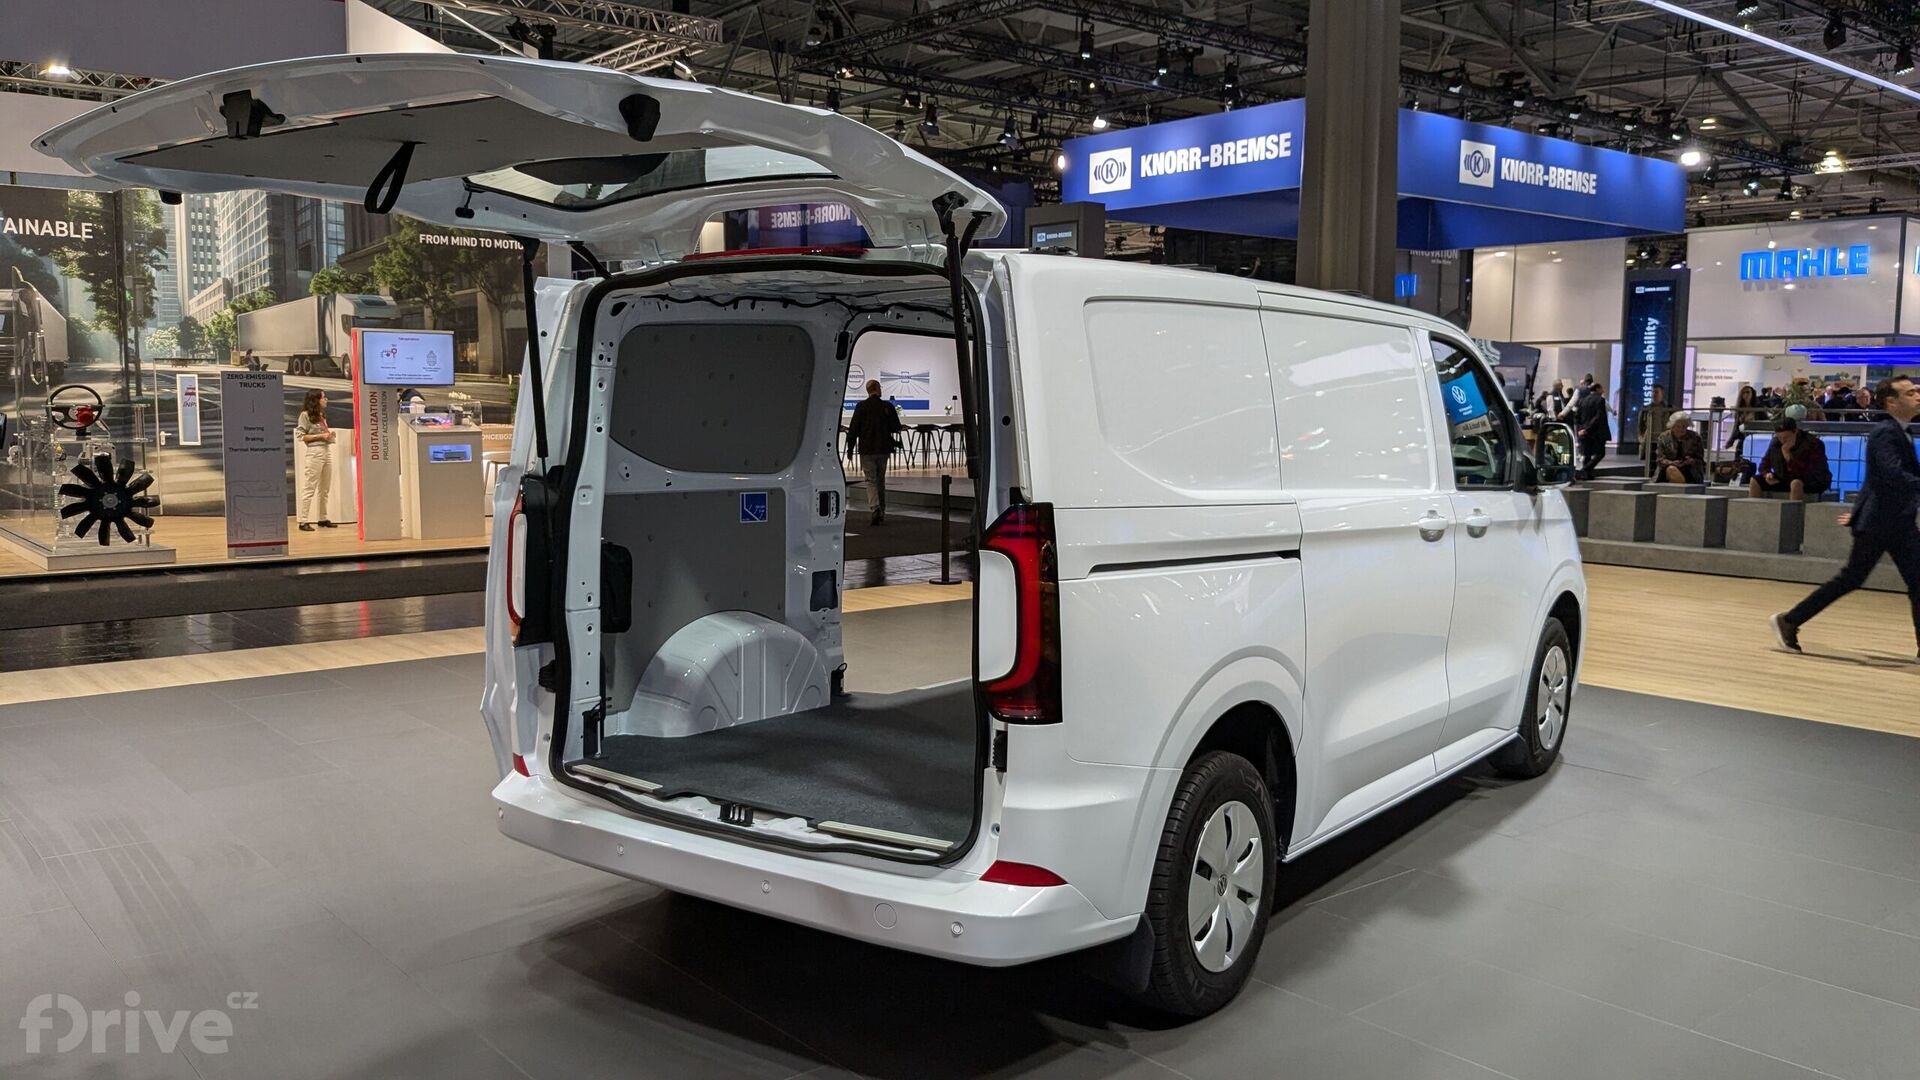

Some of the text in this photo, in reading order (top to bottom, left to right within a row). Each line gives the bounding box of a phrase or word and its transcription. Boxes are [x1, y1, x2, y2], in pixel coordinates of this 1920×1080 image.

[1140, 132, 1292, 178] KNORR-BREMSE
[1501, 157, 1598, 195] KNORR-BREMSE
[0, 217, 93, 239] AINABLE
[420, 234, 524, 250] FROM MIND TO MOTIO
[1741, 244, 1871, 281] MAHLE
[1643, 317, 1659, 406] ustainability
[369, 391, 379, 461] DIGITALIZATION
